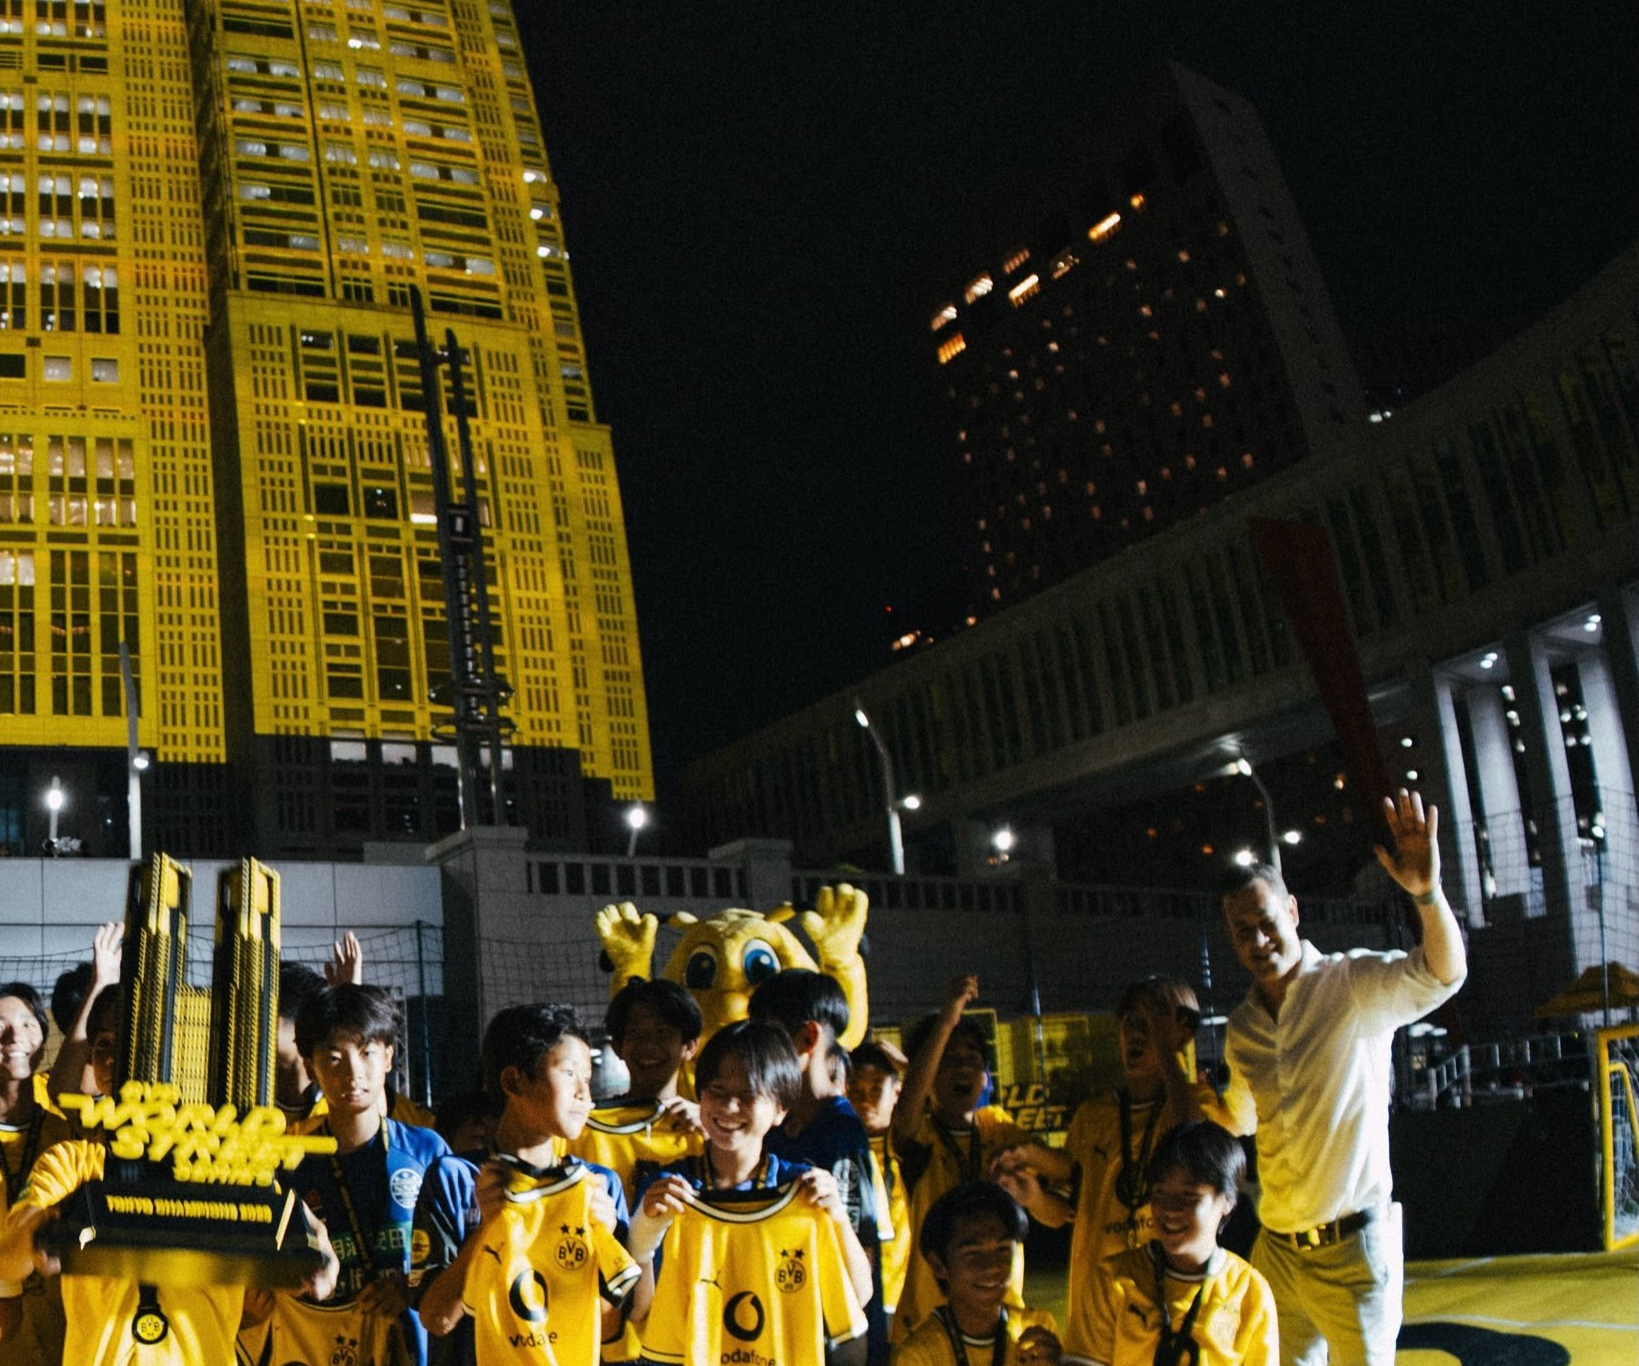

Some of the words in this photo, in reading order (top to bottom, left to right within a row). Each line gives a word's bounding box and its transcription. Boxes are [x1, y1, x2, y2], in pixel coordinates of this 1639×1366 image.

[558, 1241, 585, 1261] BVB
[778, 1263, 804, 1284] BVB
[509, 1331, 558, 1348] vodae
